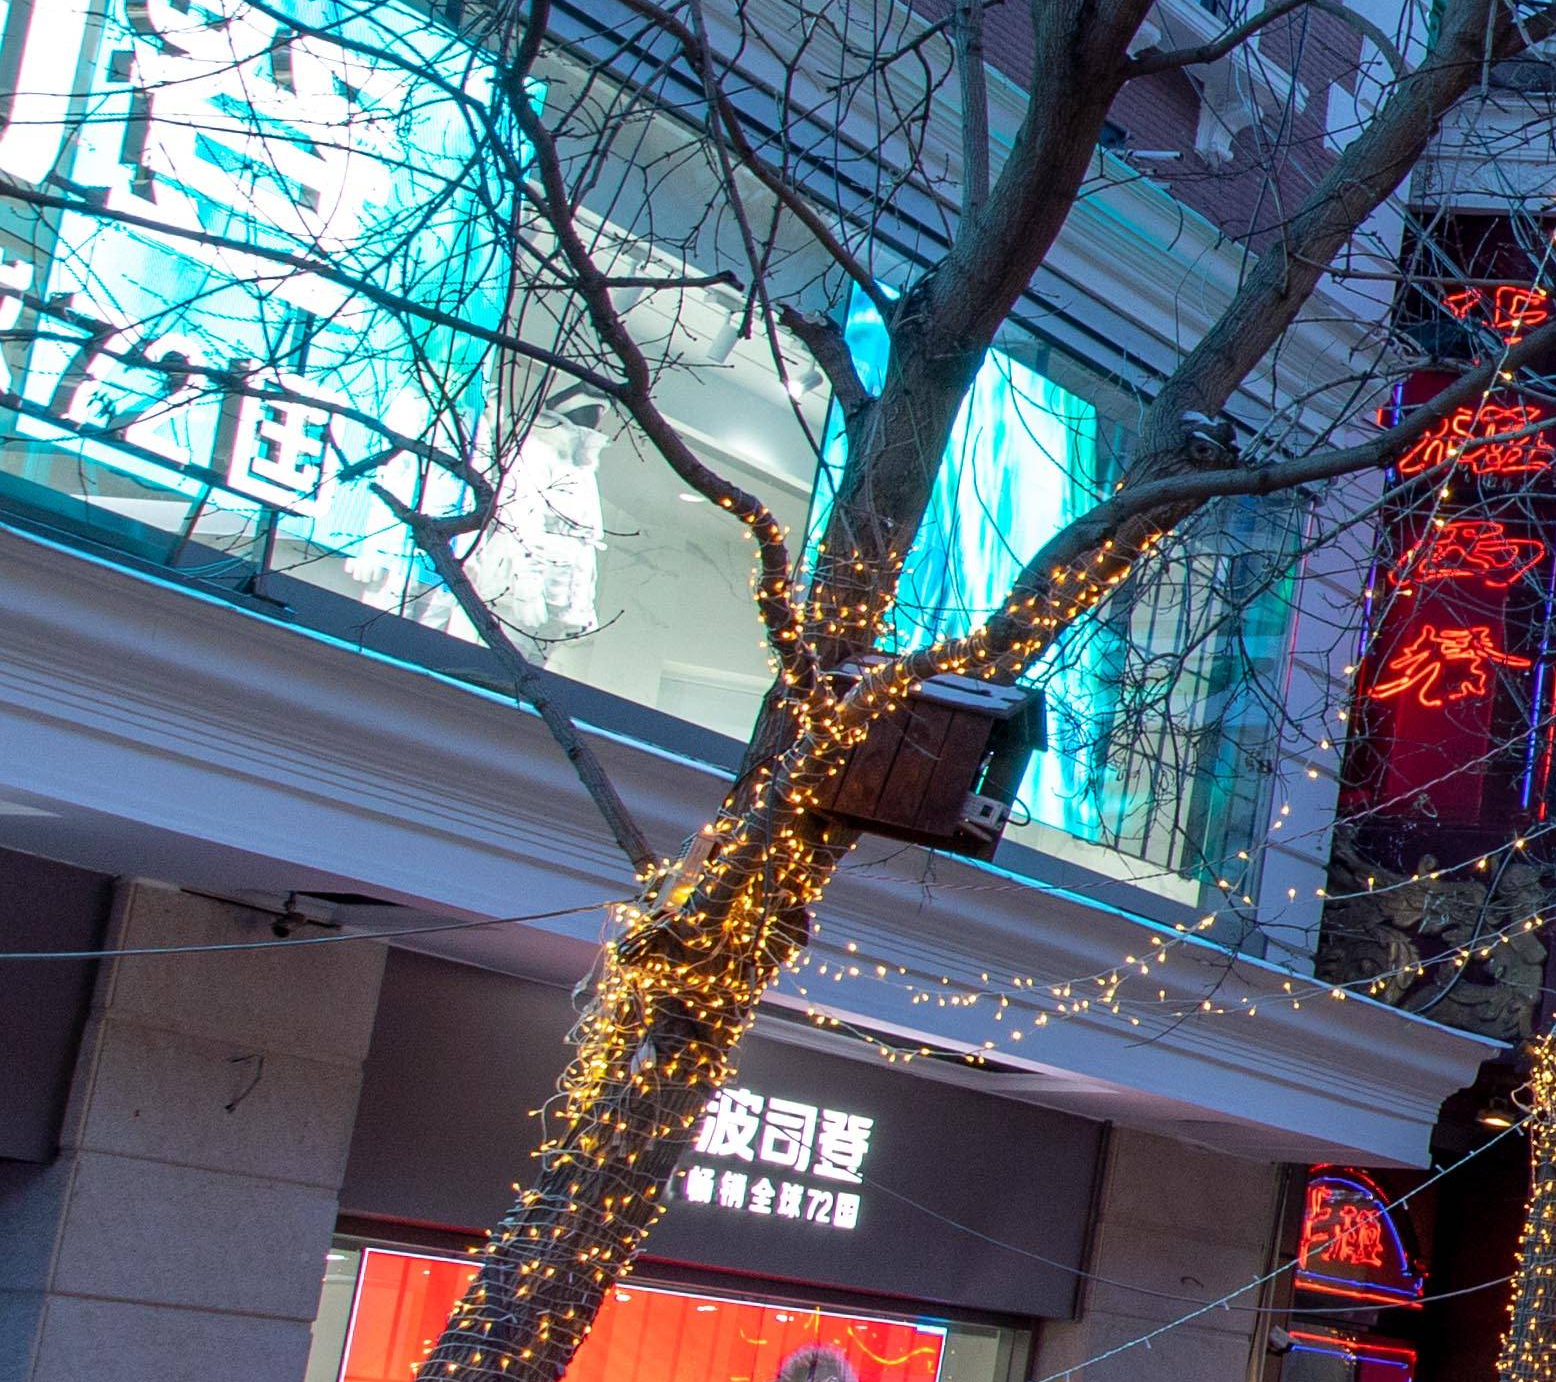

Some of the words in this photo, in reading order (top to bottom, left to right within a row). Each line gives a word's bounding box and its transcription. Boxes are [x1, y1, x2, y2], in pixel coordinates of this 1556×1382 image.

[694, 1087, 875, 1185] 波司登
[685, 1164, 861, 1230] 畅销全球72国
